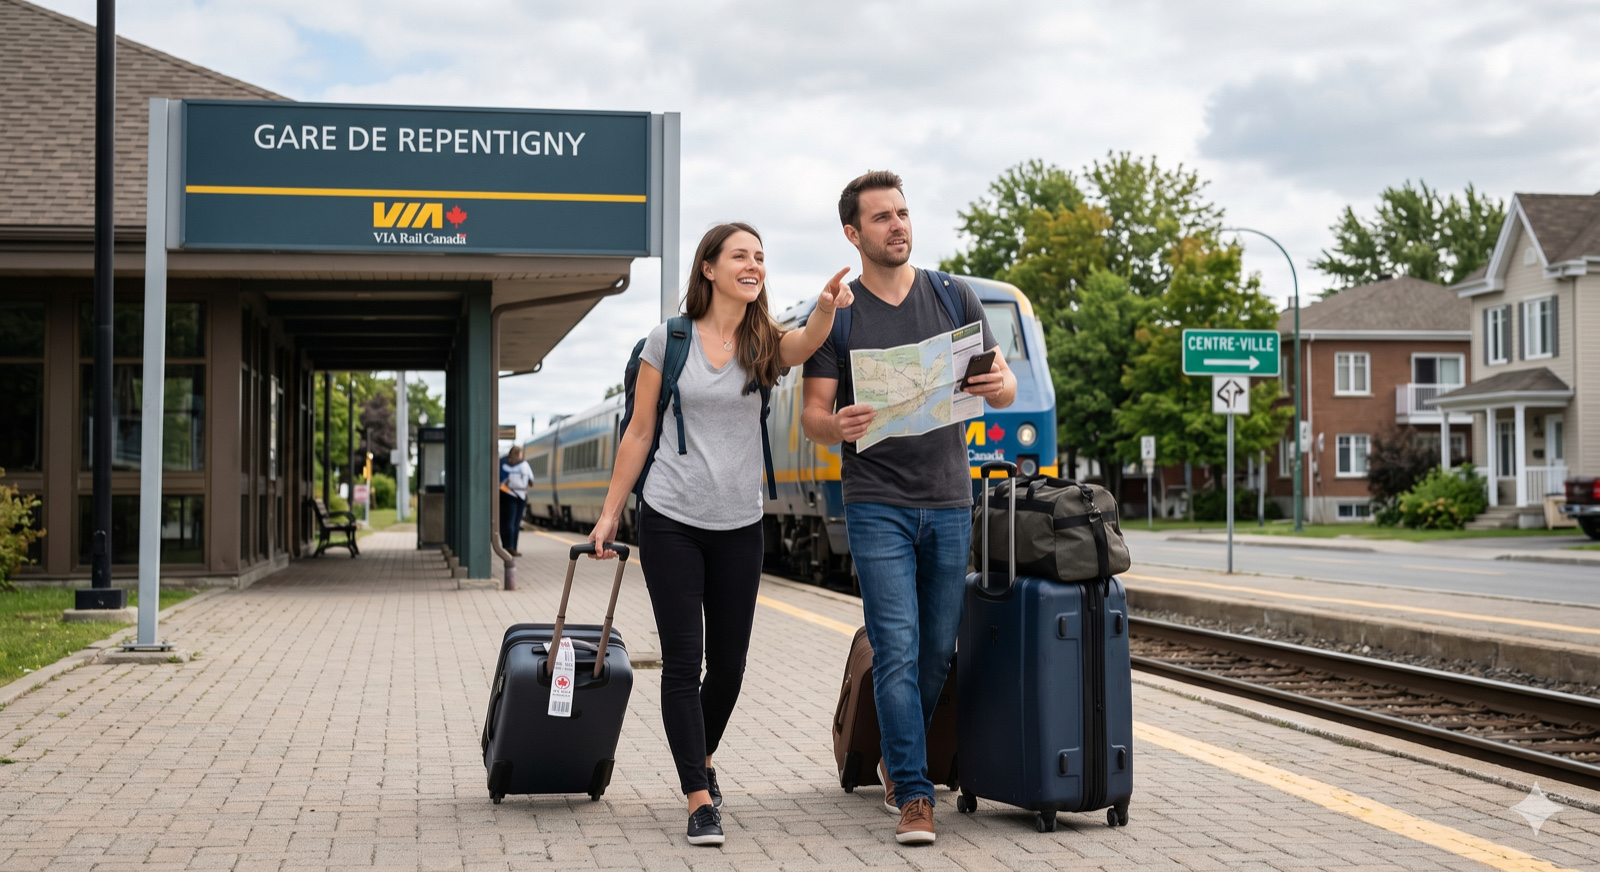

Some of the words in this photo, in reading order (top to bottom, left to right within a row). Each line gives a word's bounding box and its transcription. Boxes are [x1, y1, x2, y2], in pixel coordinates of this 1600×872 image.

[254, 123, 337, 151] GARE
[348, 126, 387, 152] DE
[398, 127, 586, 156] REPENTIGNY
[373, 202, 443, 229] VIA
[373, 232, 397, 244] VIA
[399, 232, 423, 244] Rail
[424, 233, 467, 245] Canada
[1188, 336, 1274, 352] CENTRE-VILLE
[968, 449, 1005, 461] Canada
